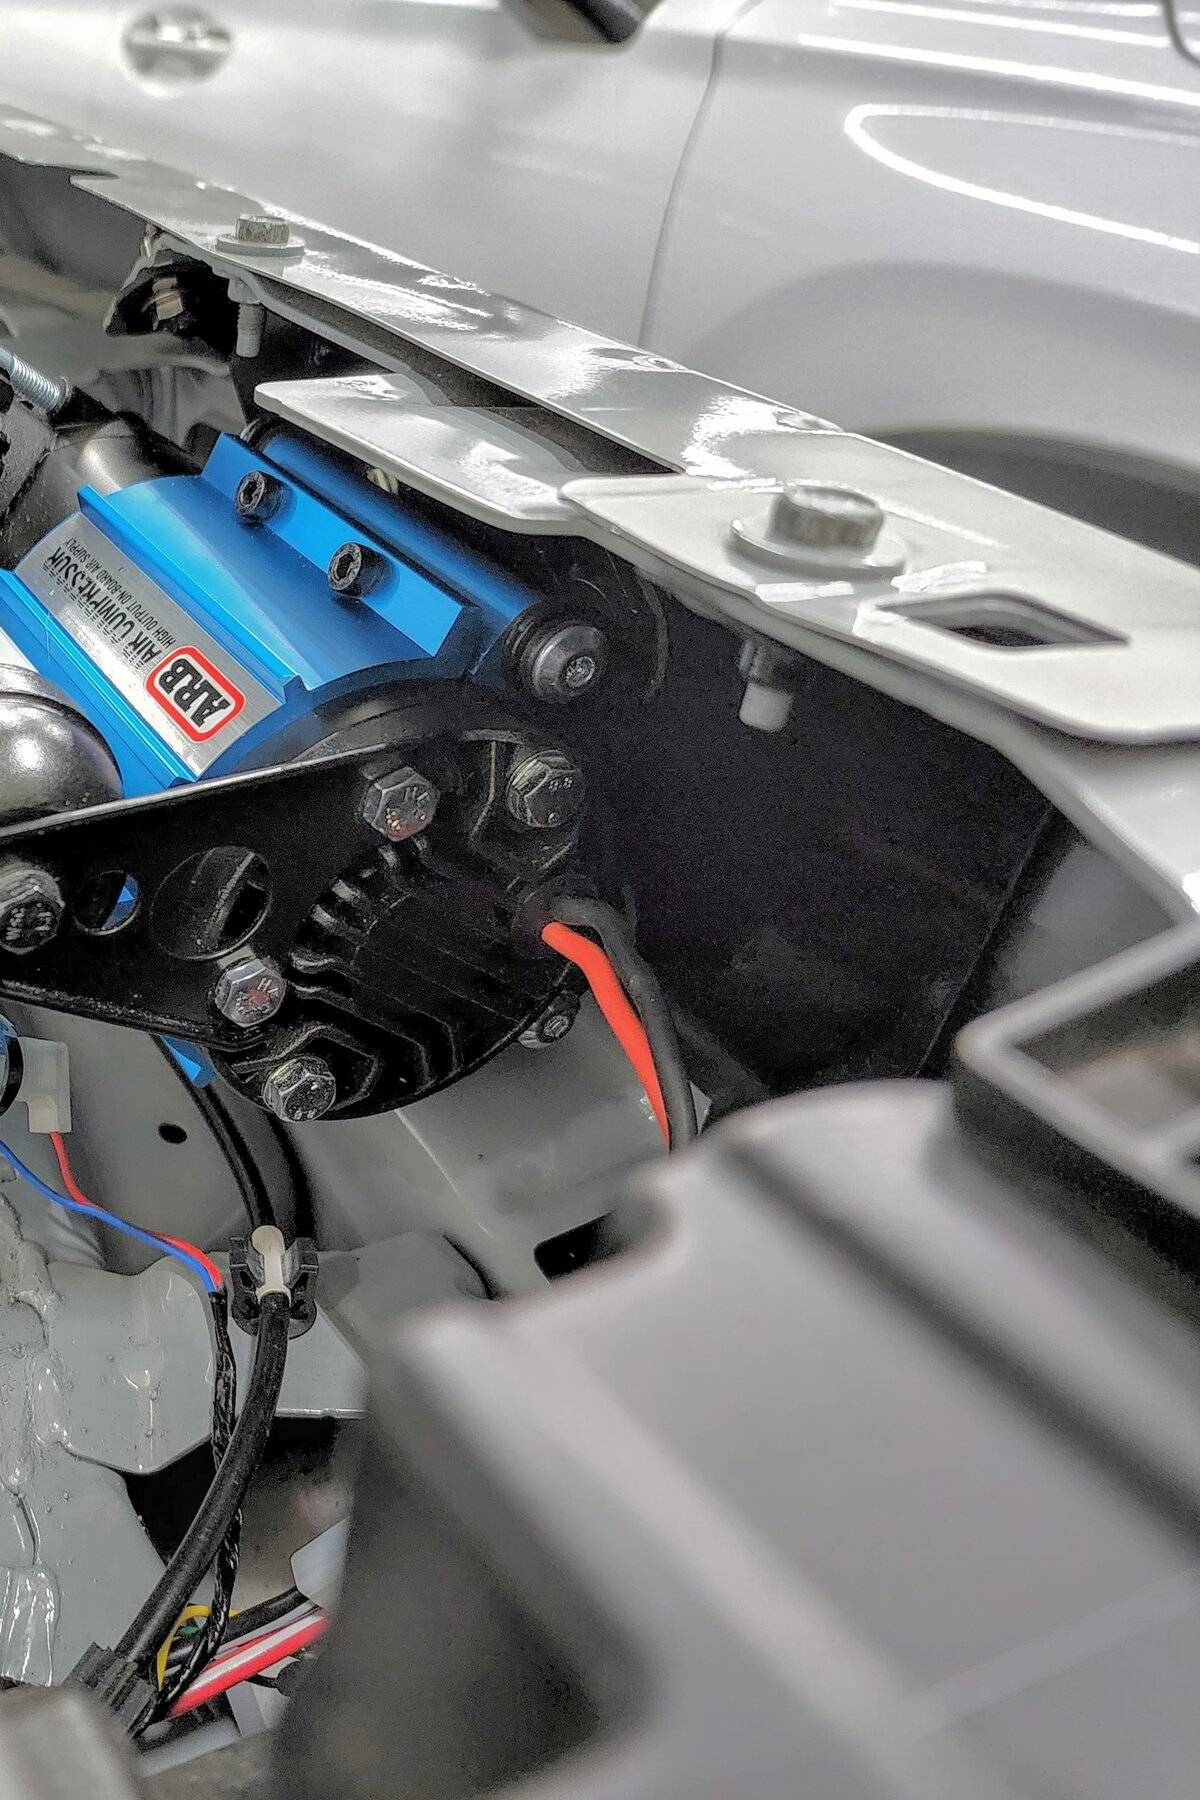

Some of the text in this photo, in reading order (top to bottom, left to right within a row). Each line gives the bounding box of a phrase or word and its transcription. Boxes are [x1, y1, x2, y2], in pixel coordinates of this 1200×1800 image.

[43, 547, 162, 669] AIR COMPRESSOR
[63, 538, 177, 649] HIGH OUTPUT ON-BOARD AIR SUPPLY
[159, 658, 231, 728] ARB
